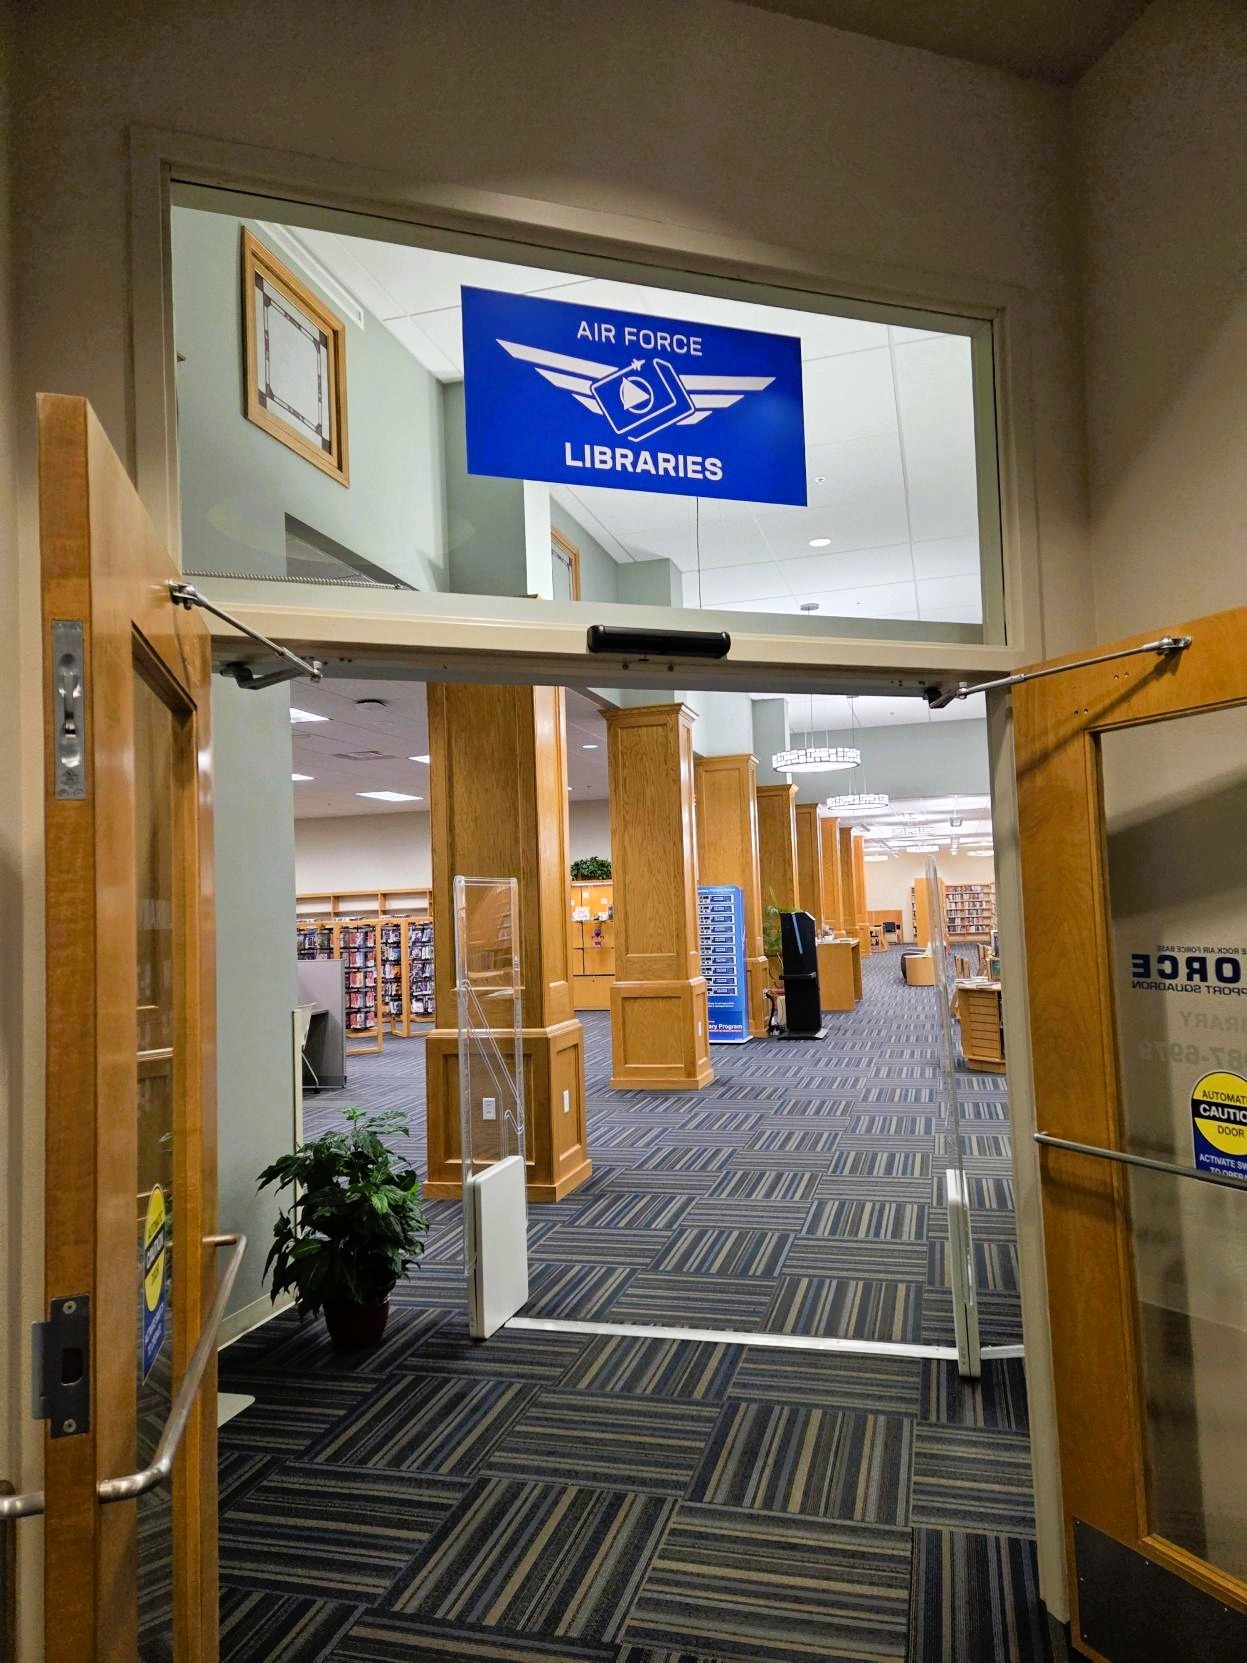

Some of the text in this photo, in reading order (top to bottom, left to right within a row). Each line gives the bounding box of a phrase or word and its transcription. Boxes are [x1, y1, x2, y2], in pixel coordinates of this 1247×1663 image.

[577, 321, 703, 356] AIR FORCE
[565, 442, 723, 481] LIBRARIES
[718, 1023, 743, 1031] Program
[1217, 1124, 1245, 1138] DOOR
[1199, 1153, 1235, 1169] ACTIVATE
